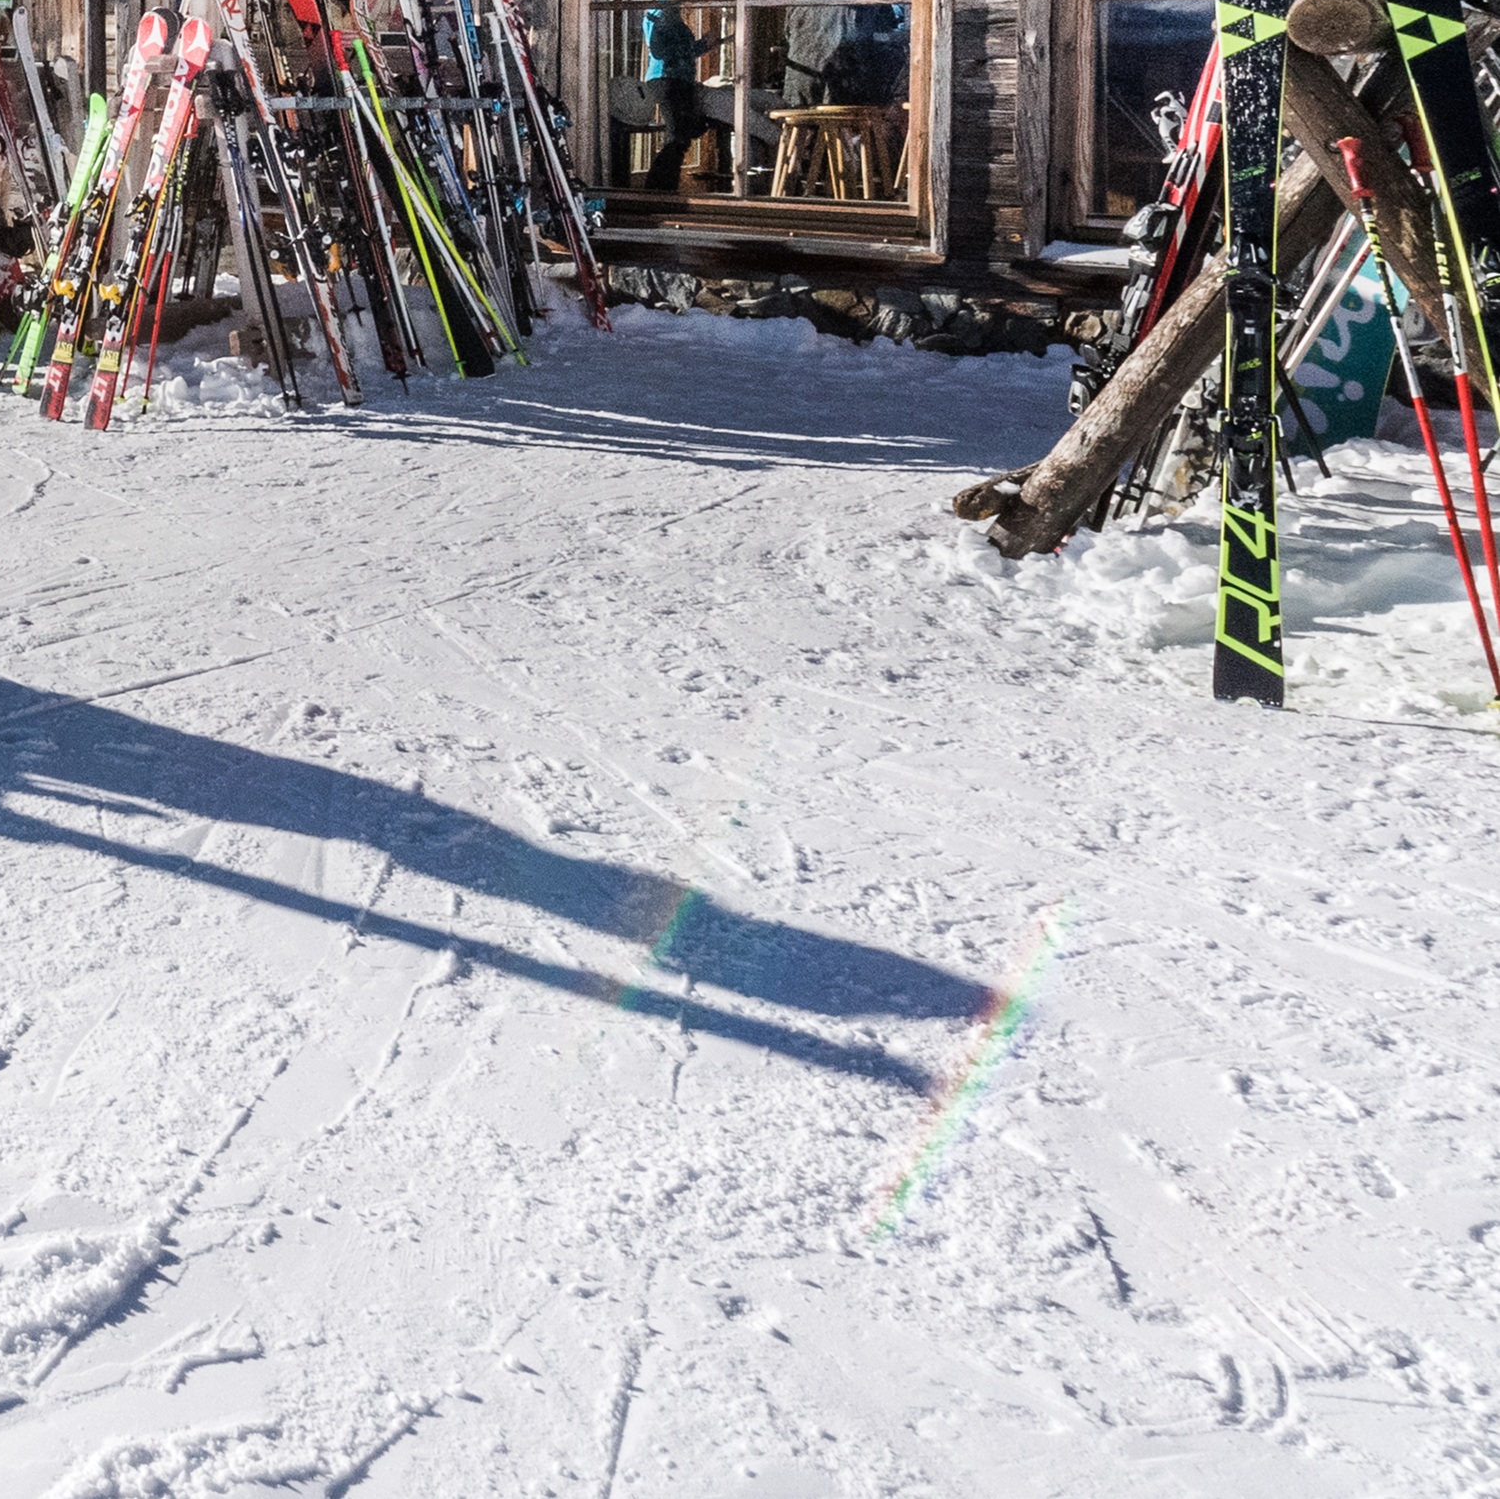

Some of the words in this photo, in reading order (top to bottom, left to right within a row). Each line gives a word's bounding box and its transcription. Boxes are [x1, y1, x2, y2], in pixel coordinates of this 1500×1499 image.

[105, 51, 145, 172] ATOMIC
[150, 58, 189, 175] ATOMIC
[1434, 241, 1451, 285] LEKI
[48, 367, 62, 392] LT
[93, 377, 107, 402] LT
